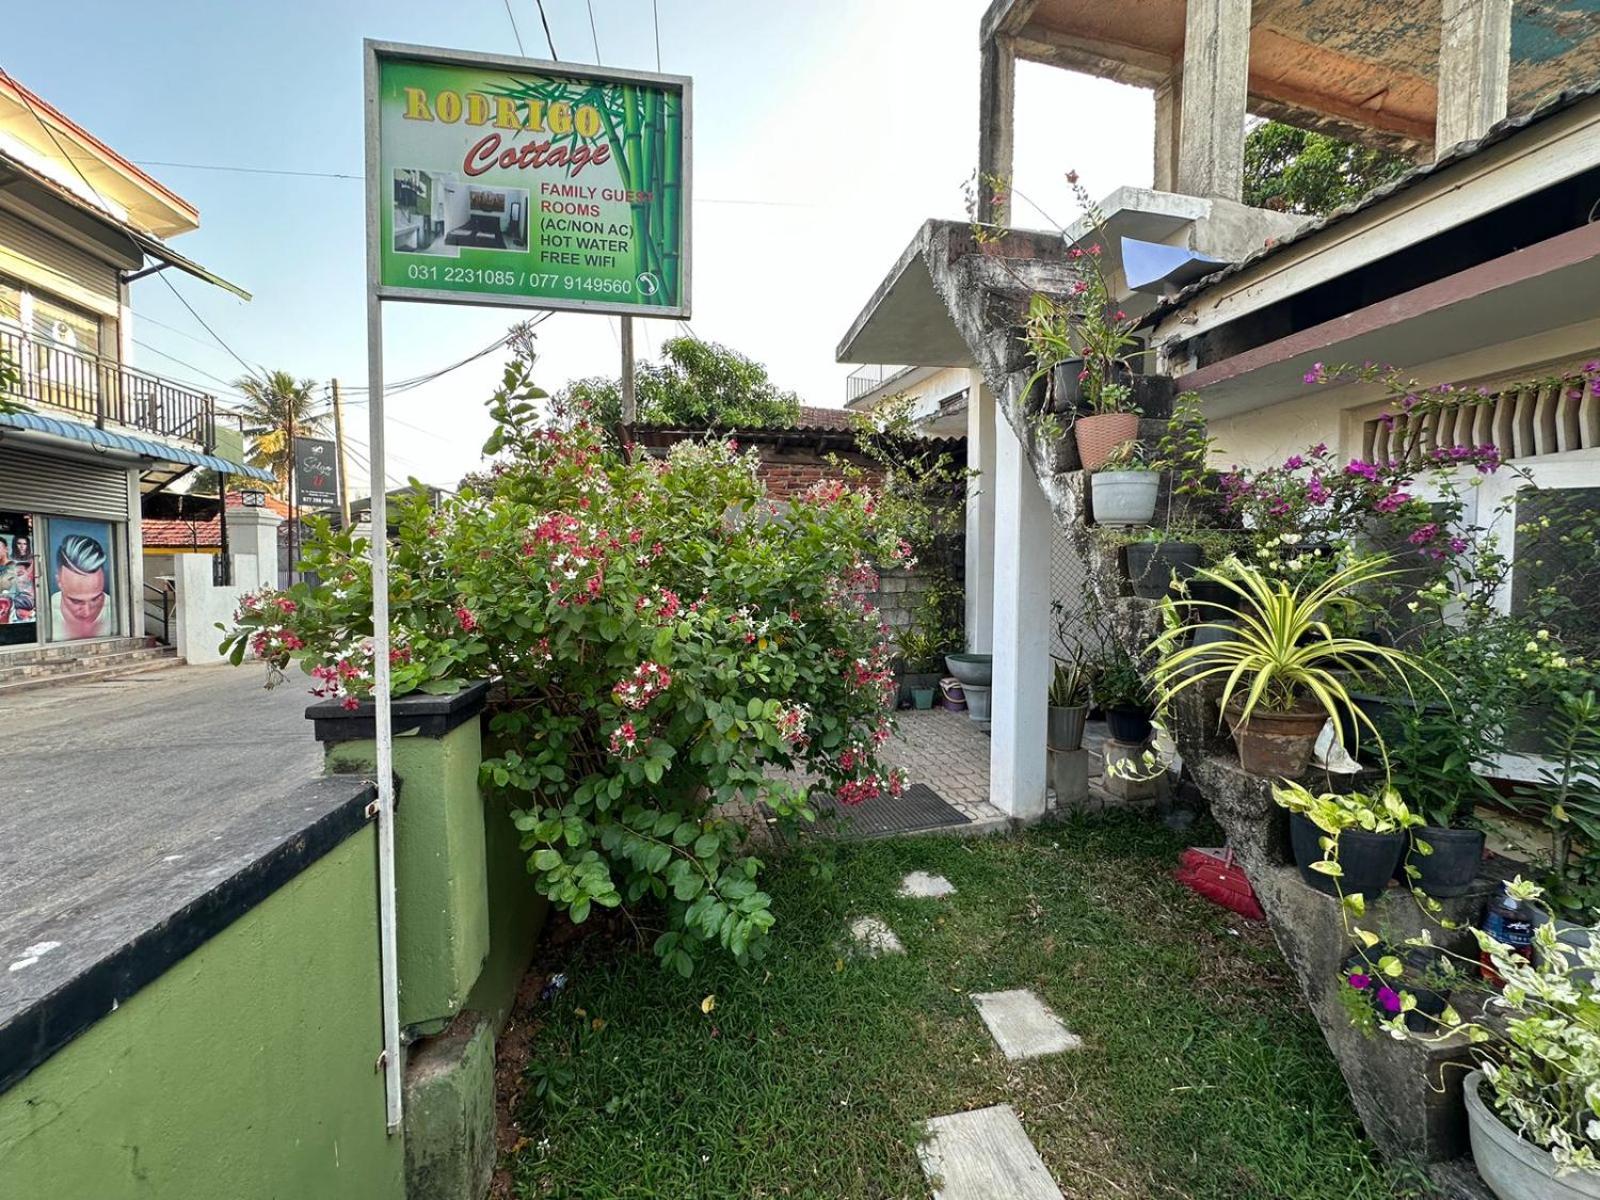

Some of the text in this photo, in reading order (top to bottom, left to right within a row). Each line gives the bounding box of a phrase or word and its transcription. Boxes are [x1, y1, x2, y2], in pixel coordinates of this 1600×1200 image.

[403, 87, 601, 137] RODRIGO
[463, 133, 611, 178] Cottage
[540, 182, 597, 199] FAMILY
[540, 200, 600, 217] ROOMS
[540, 217, 634, 239] (AC/NON AC)
[540, 234, 628, 253] HOT WATER
[540, 251, 616, 268] FREE WIFI
[407, 264, 437, 280] 031
[444, 267, 515, 286] 2231085
[529, 273, 559, 289] 077
[564, 276, 632, 295] 9149560
